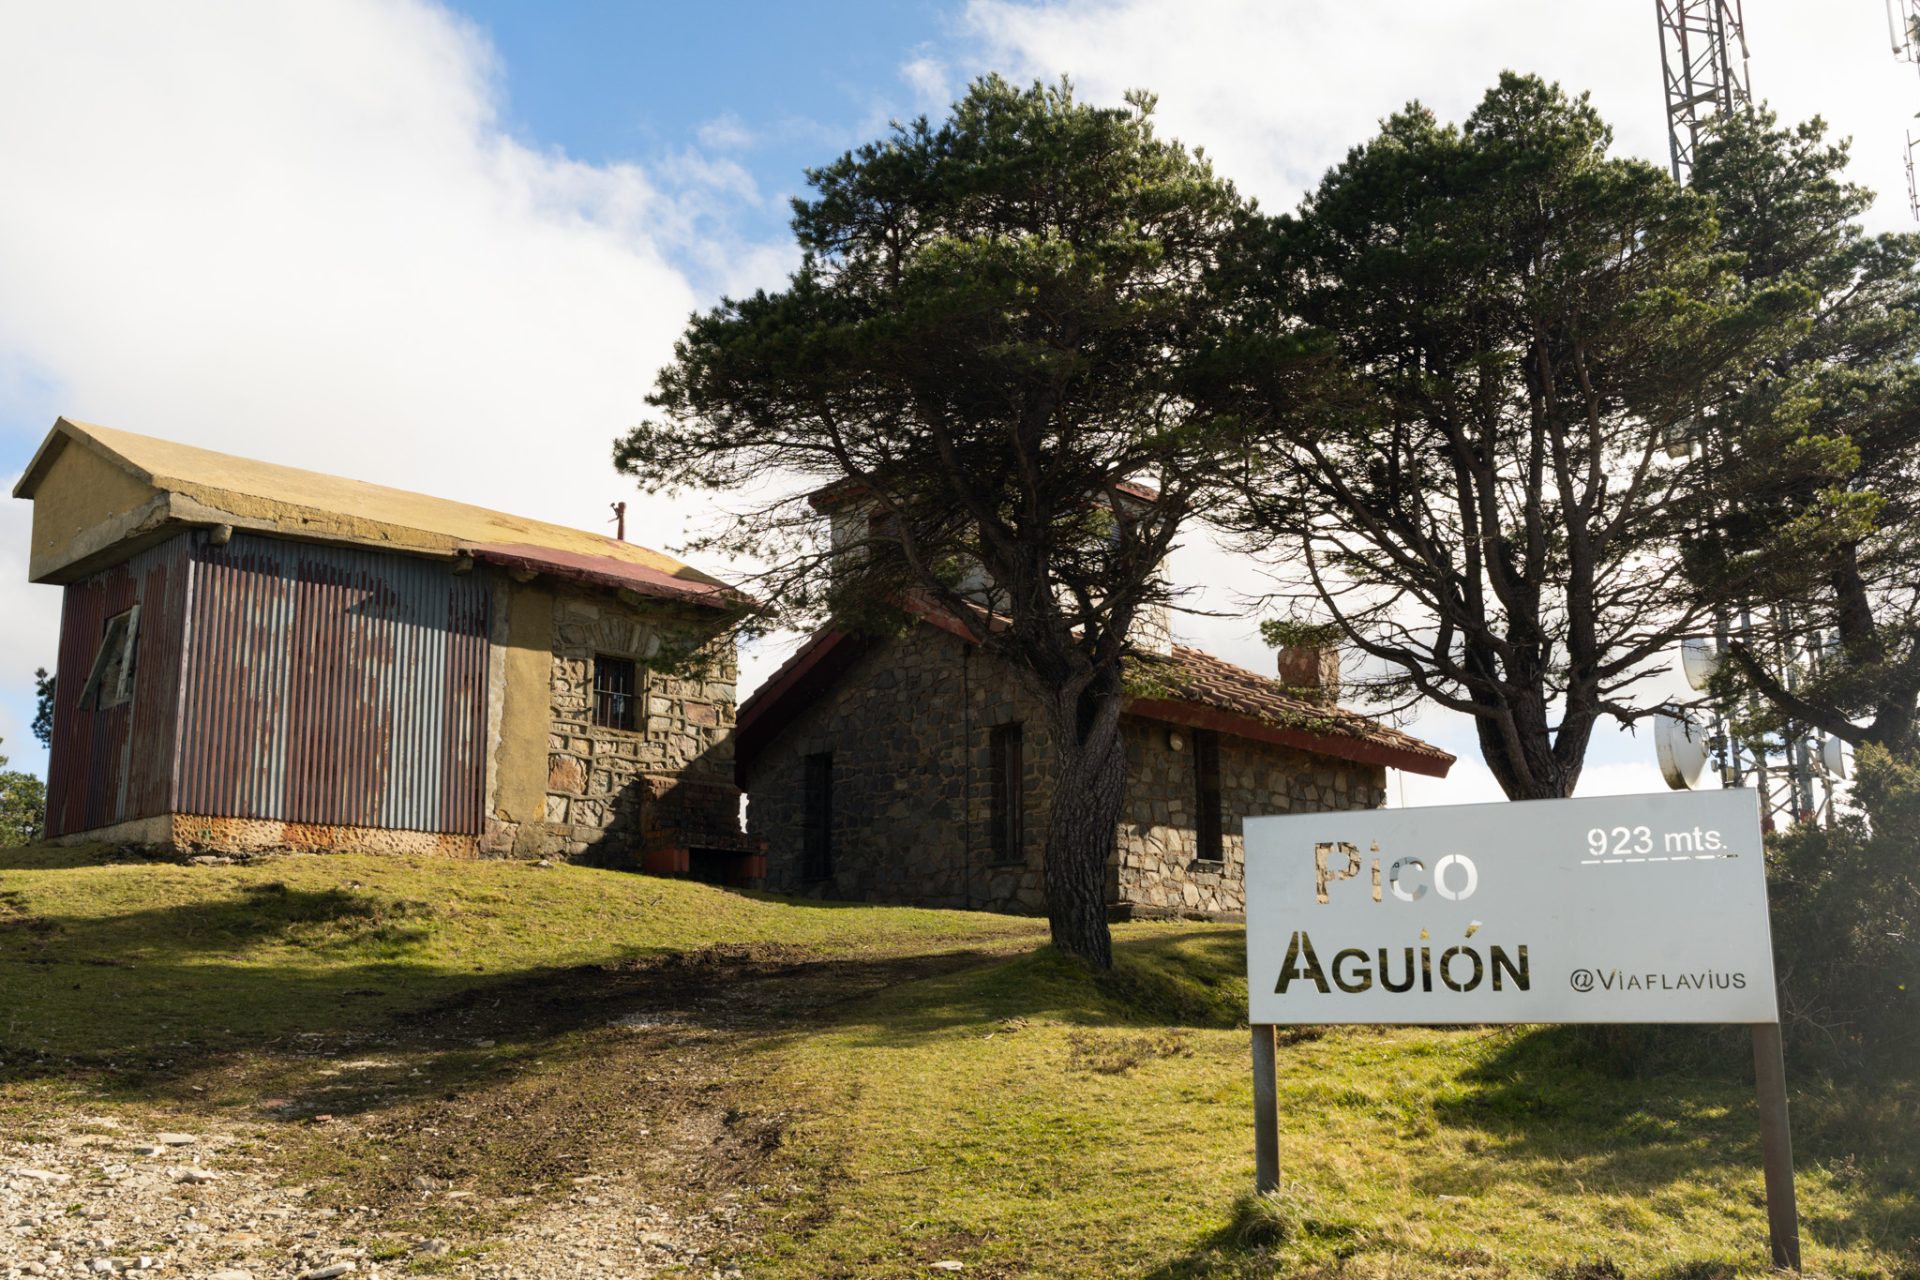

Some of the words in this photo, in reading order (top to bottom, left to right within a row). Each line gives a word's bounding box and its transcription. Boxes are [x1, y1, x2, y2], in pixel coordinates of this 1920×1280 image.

[1587, 826, 1654, 856] 923
[1664, 826, 1728, 852] mts.
[1315, 839, 1478, 904] Pico
